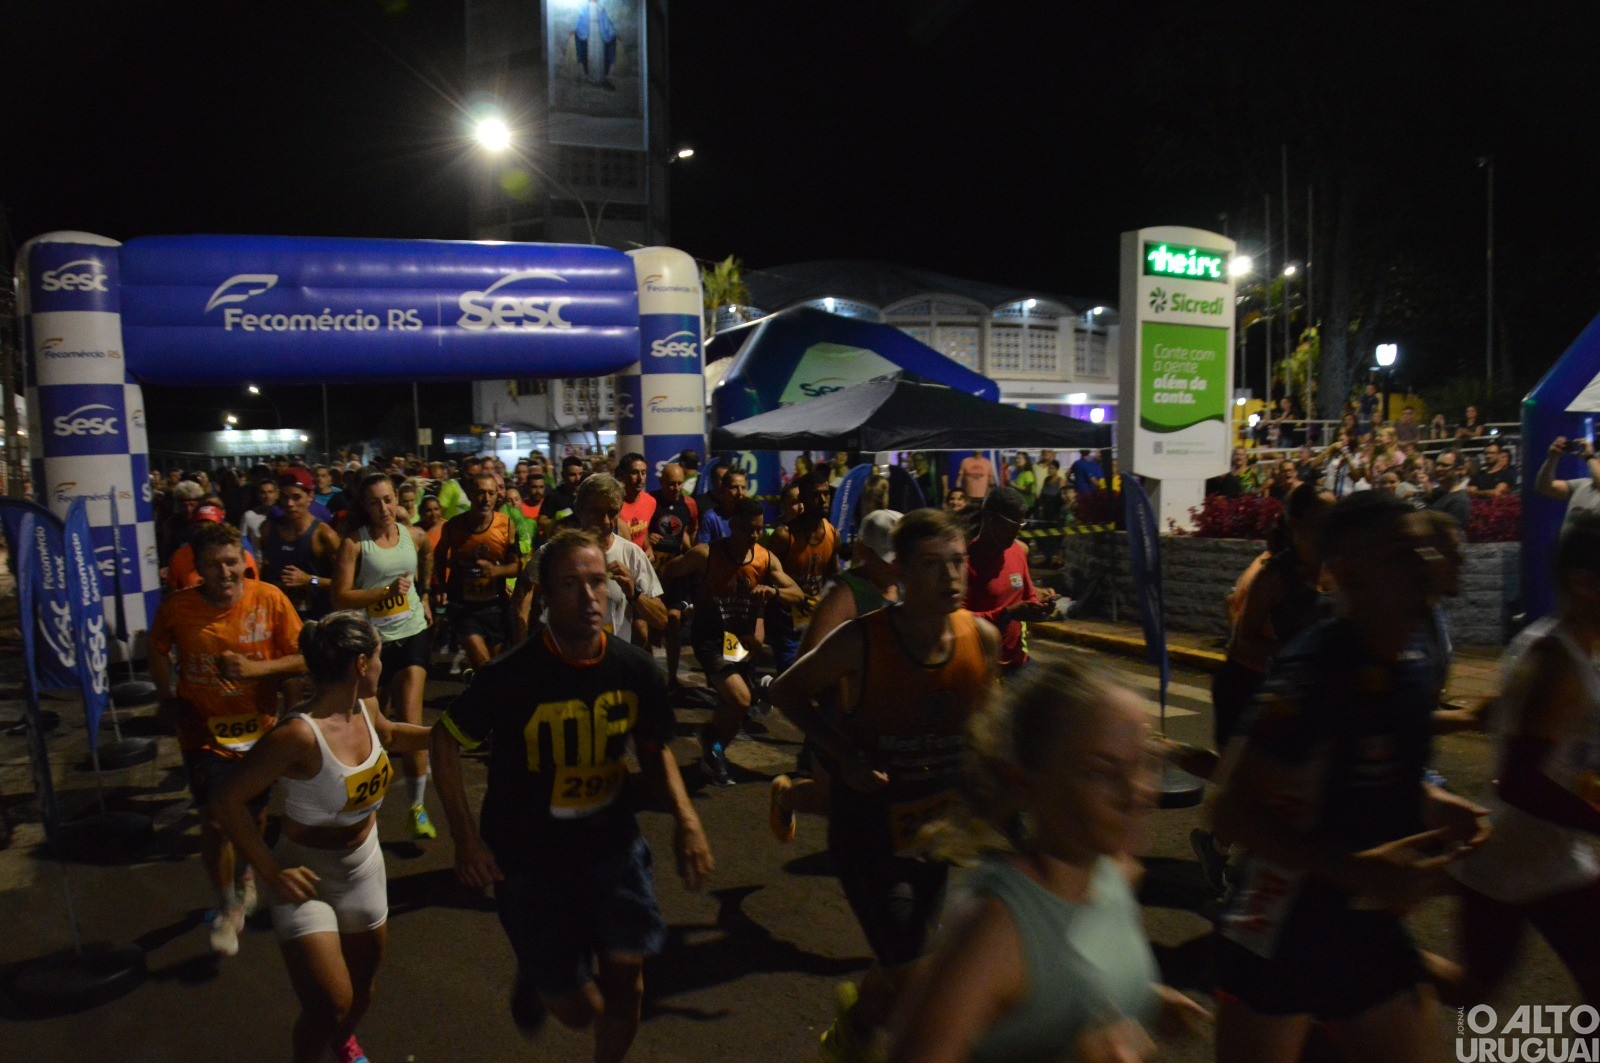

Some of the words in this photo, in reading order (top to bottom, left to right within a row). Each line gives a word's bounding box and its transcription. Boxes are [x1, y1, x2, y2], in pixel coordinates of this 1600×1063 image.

[42, 268, 108, 292] Sesc
[456, 288, 573, 331] Sesc
[1170, 292, 1225, 316] Sicredi
[223, 308, 381, 332] Fecomércio
[387, 309, 424, 332] RS
[650, 336, 698, 358] Sesc
[1153, 343, 1188, 359] Conte
[1189, 349, 1215, 361] com
[1153, 373, 1188, 389] além
[1189, 376, 1207, 390] da
[53, 415, 119, 436] Sesc
[86, 614, 110, 695] Sesc
[215, 720, 259, 738] 266
